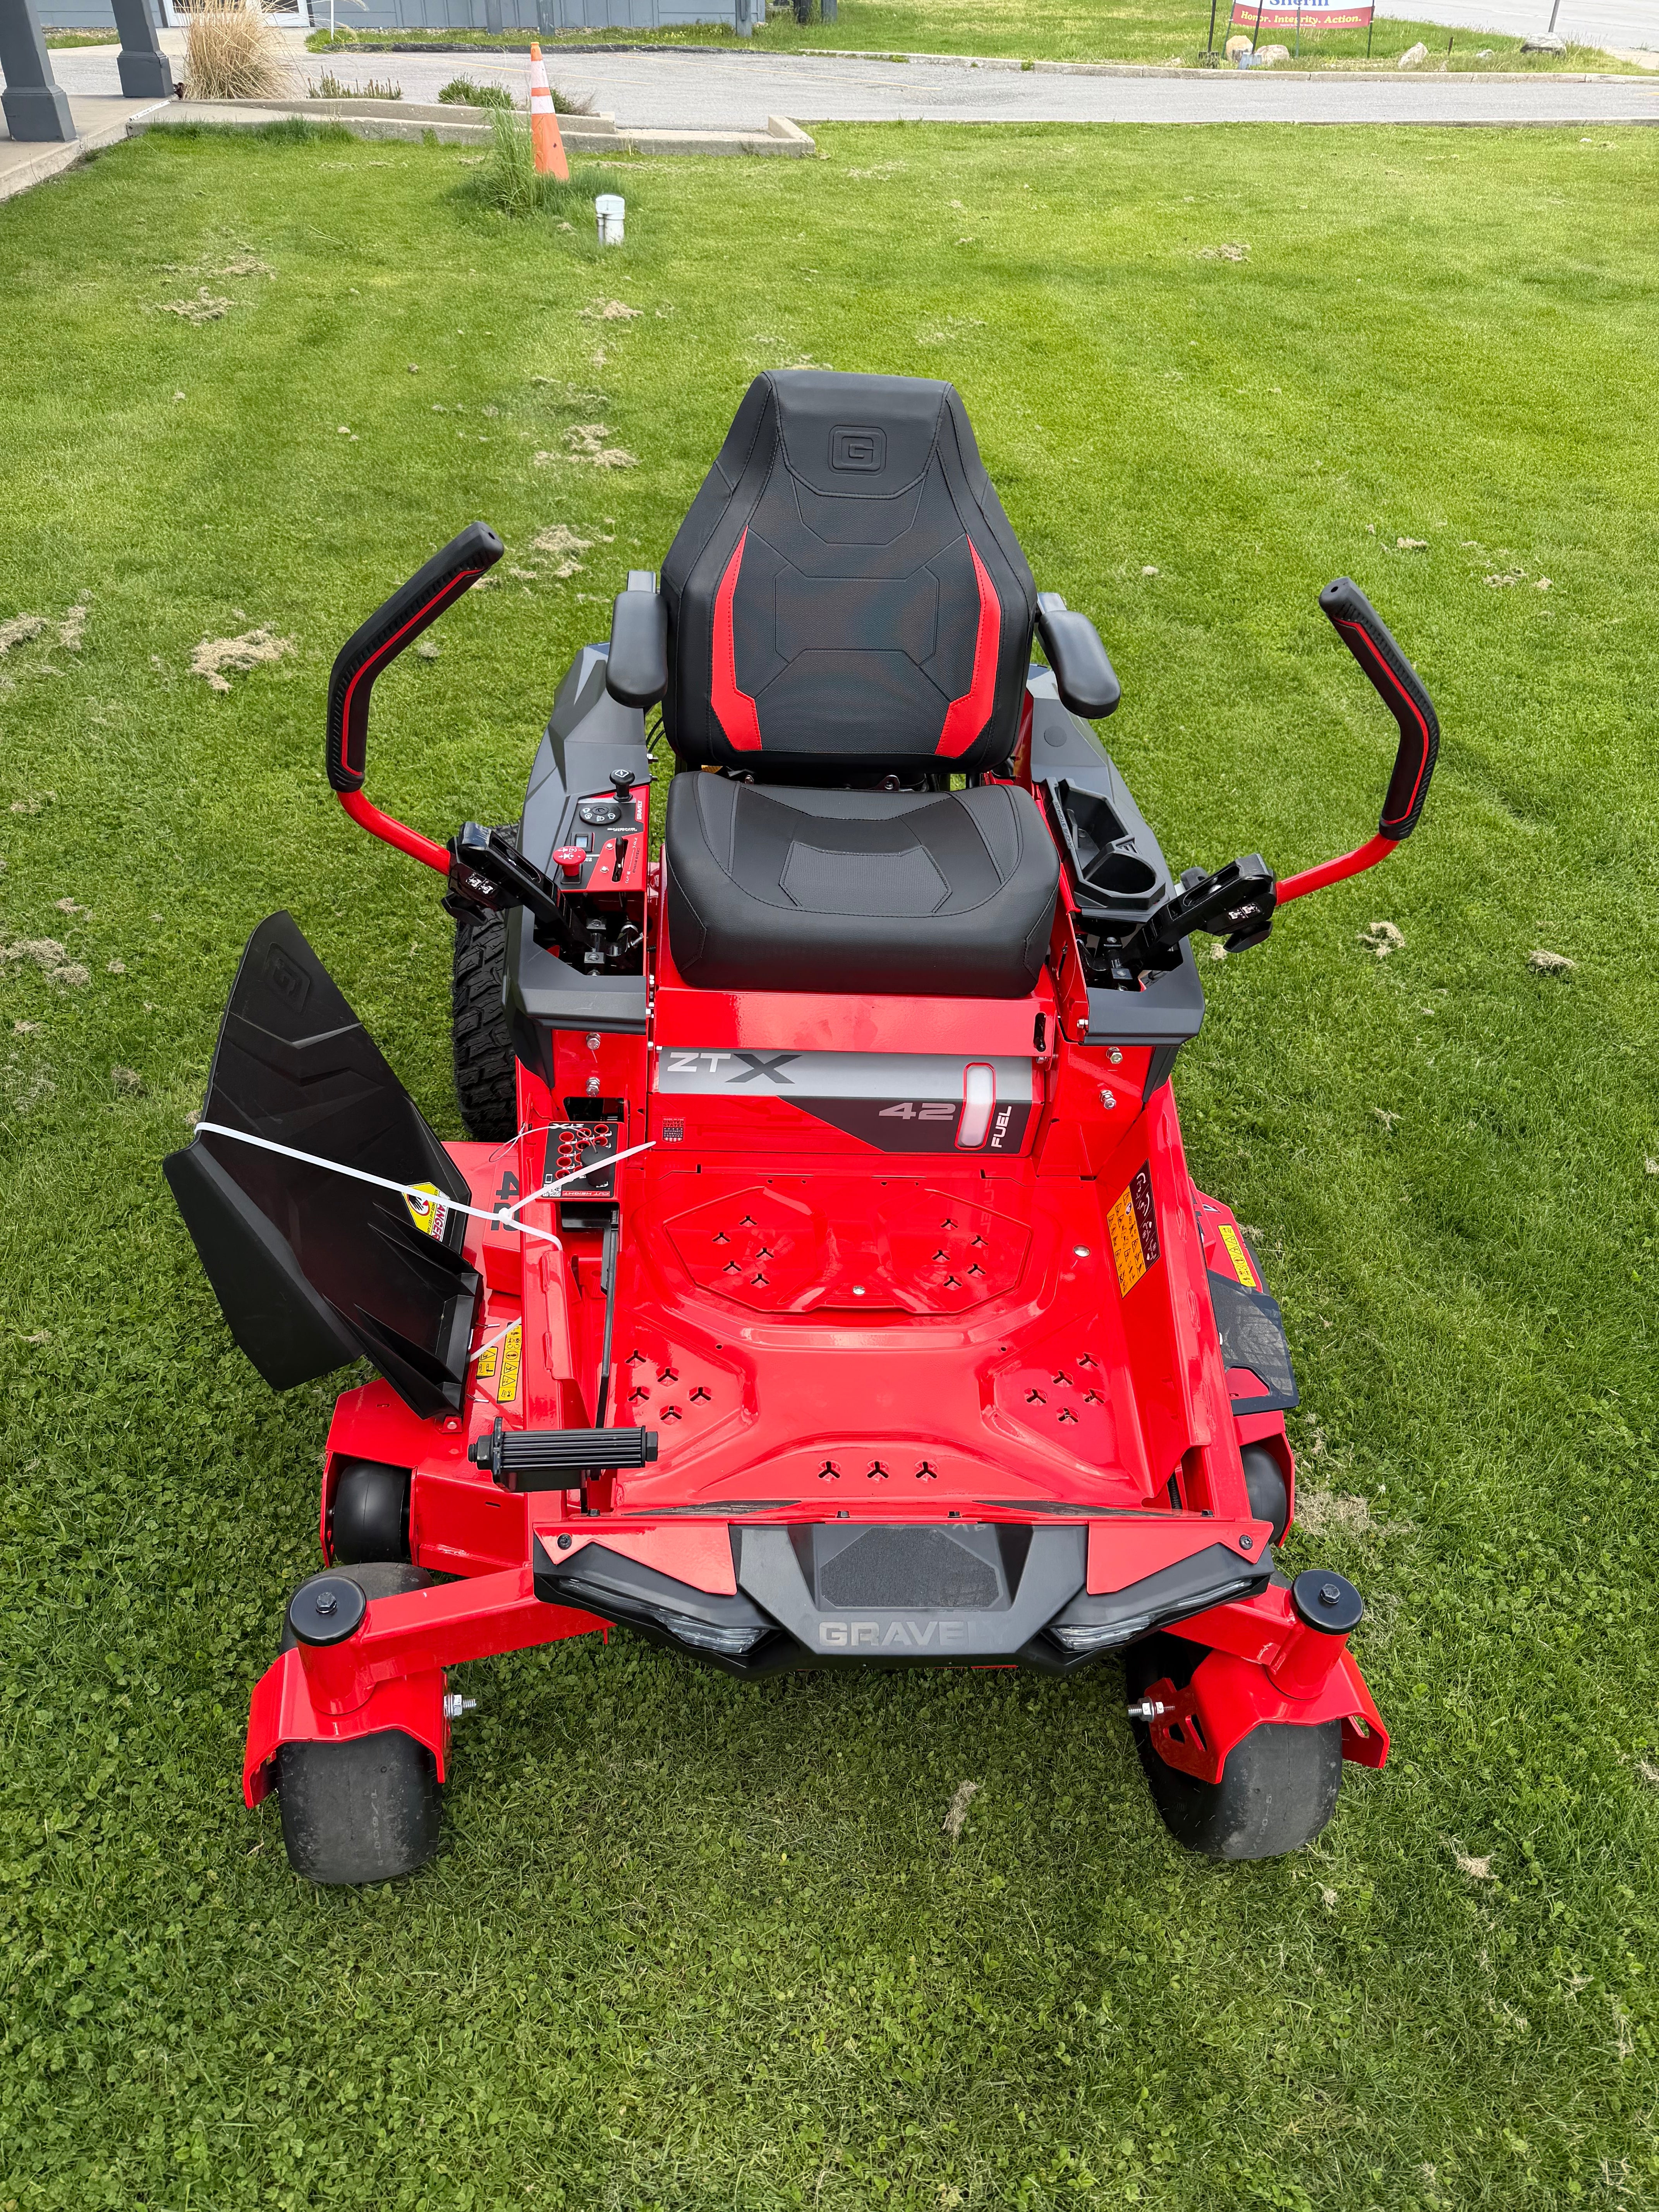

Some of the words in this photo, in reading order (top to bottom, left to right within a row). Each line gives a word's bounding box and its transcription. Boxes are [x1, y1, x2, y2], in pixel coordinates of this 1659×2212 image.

[1324, 15, 1362, 24] Action.
[667, 1052, 802, 1084] ZTX
[879, 1102, 956, 1120] 42
[991, 1106, 1012, 1148] FUEL
